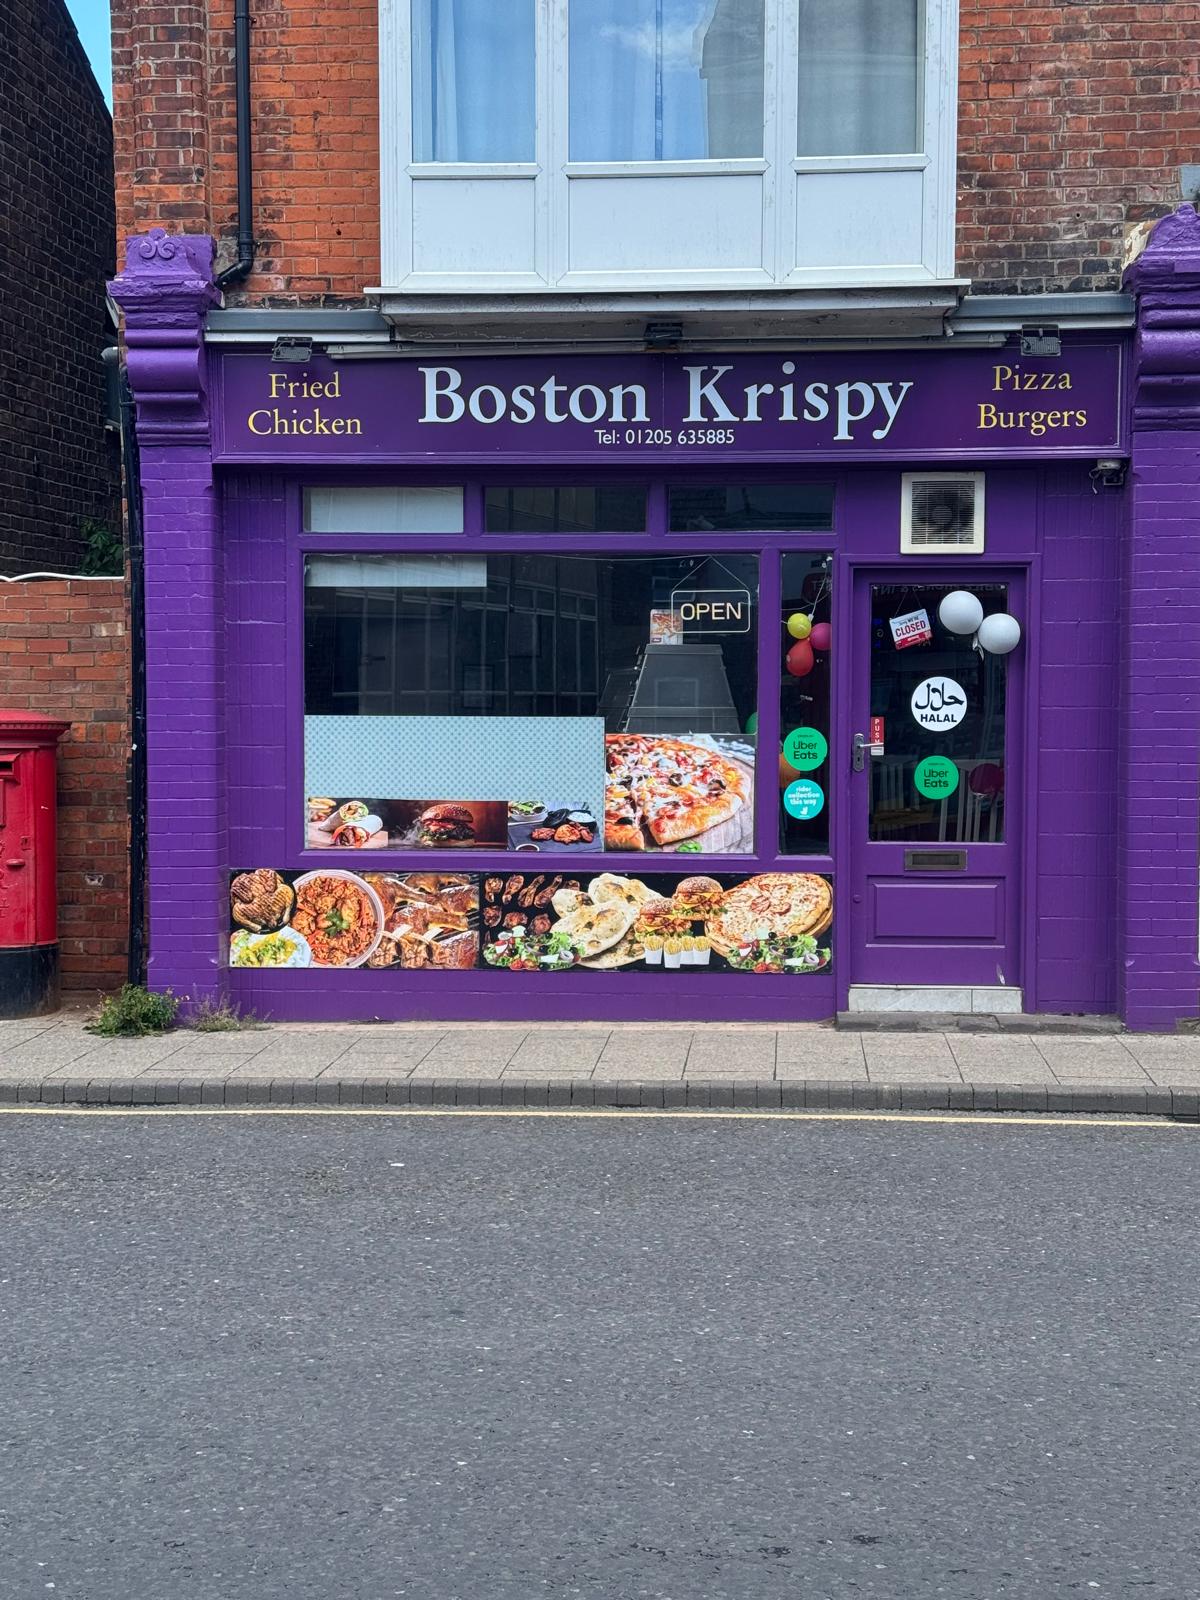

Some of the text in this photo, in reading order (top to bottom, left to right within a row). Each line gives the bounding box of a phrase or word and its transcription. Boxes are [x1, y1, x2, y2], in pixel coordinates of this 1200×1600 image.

[268, 371, 341, 398] Fried
[992, 364, 1073, 391] Pizza
[418, 361, 914, 441] Boston Krispy
[247, 407, 363, 436] Chicken
[977, 403, 1087, 436] Burgers
[594, 429, 735, 445] Tel: 01205 635885
[680, 602, 742, 621] OPEN
[895, 620, 926, 637] CLOSED
[914, 682, 965, 712] حلال
[920, 713, 957, 723] HALAL
[793, 740, 817, 750] Uber
[793, 750, 818, 760] Eats
[923, 769, 948, 778] Uber
[923, 778, 949, 788] Eats
